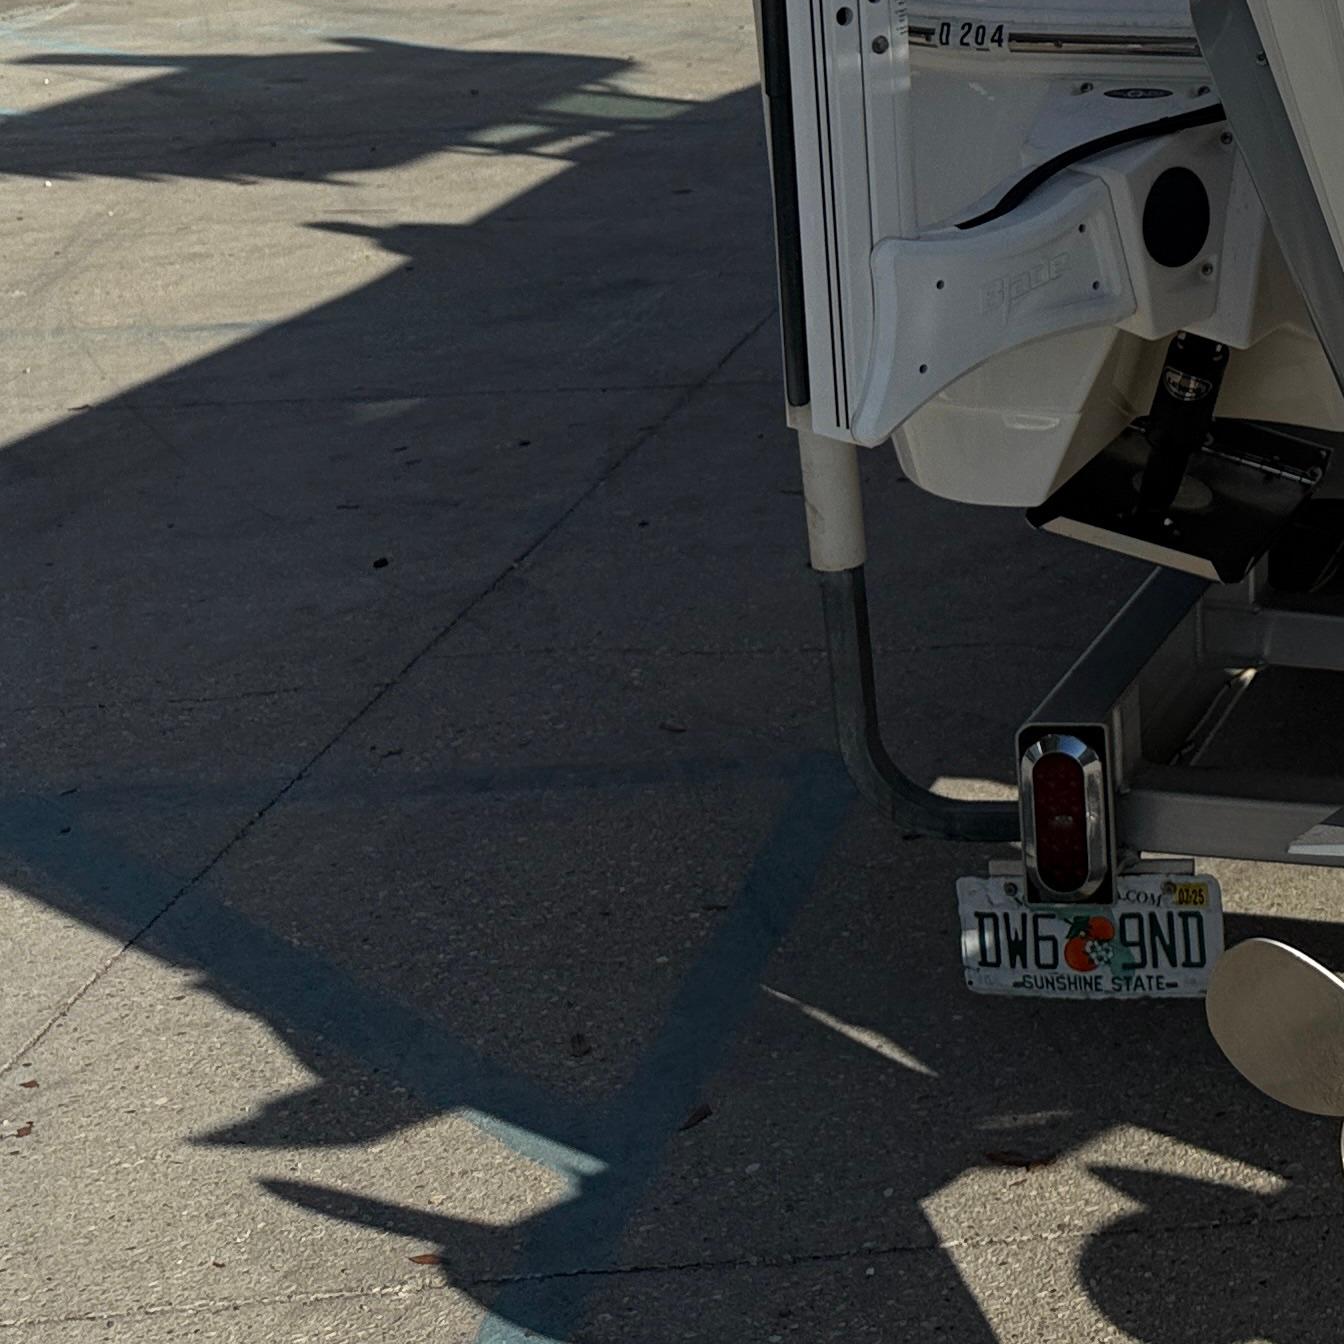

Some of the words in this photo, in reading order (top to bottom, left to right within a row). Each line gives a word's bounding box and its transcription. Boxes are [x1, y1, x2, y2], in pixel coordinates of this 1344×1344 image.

[973, 910, 1059, 969] DW6
[1118, 910, 1207, 969] 9ND
[1022, 974, 1104, 992] SUNSHINE
[1111, 975, 1166, 992] STATE
